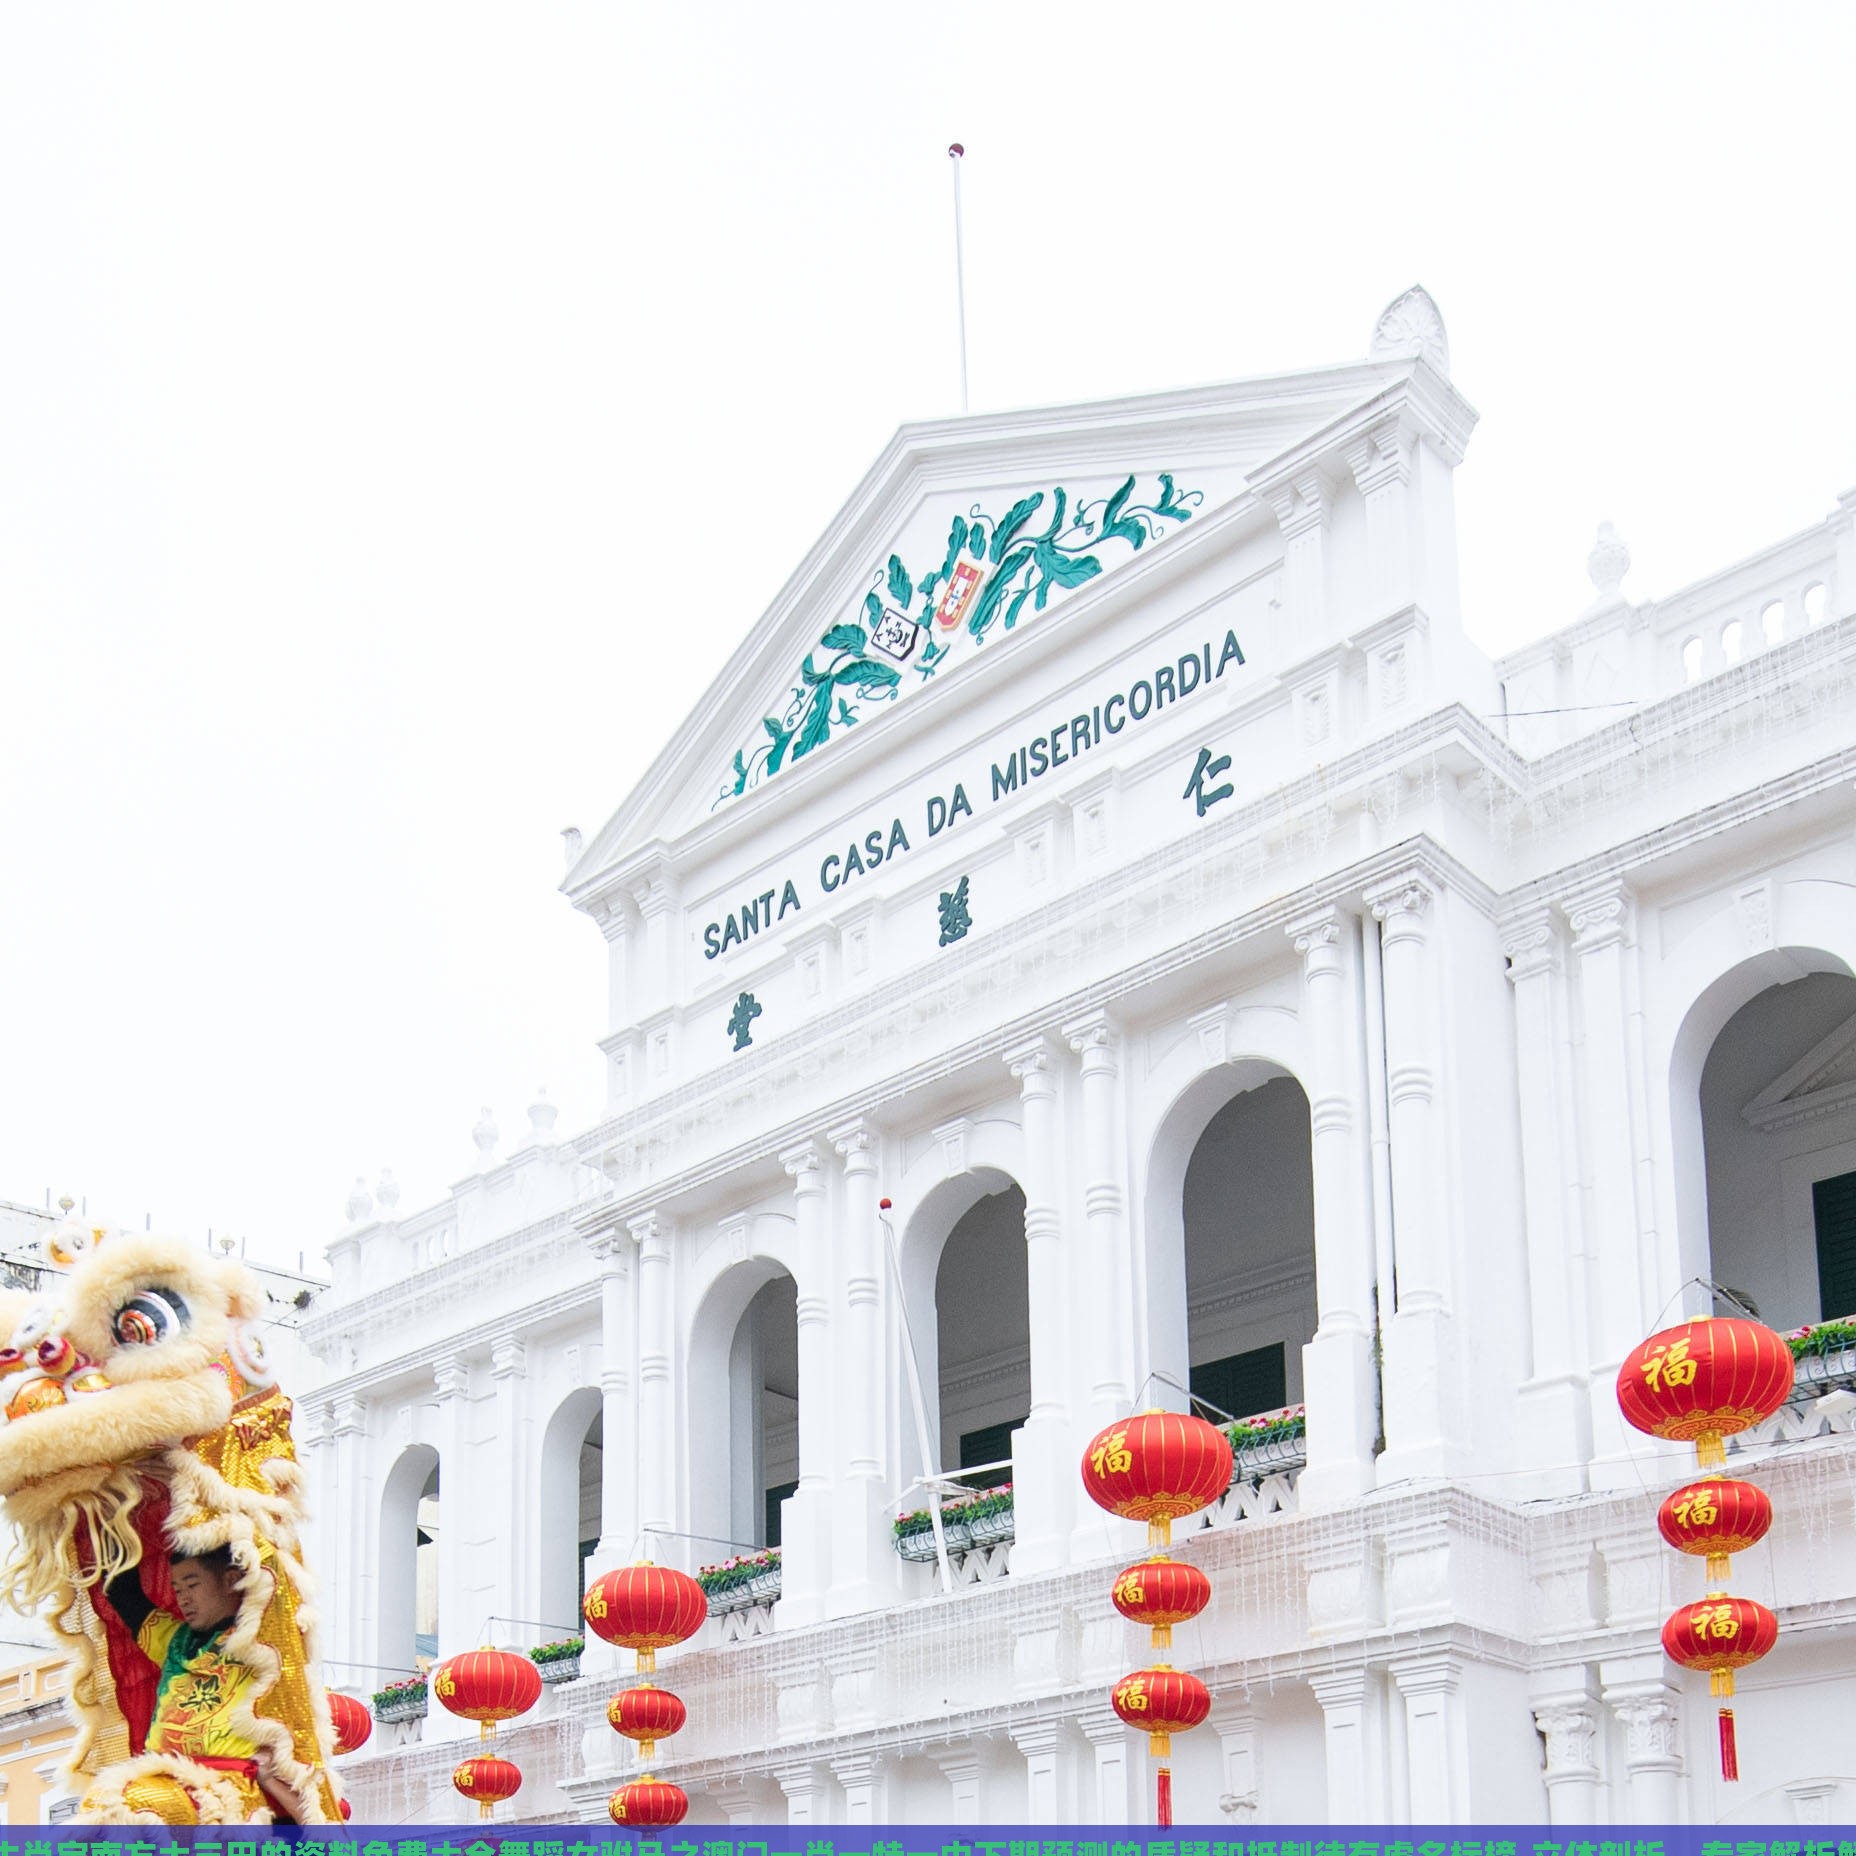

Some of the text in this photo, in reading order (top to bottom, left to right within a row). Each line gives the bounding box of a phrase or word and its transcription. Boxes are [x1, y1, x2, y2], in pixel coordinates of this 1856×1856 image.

[703, 879, 801, 961] SANTA
[820, 818, 911, 894] CASA
[927, 785, 973, 837] DA
[991, 629, 1247, 804] MISERICORDIA
[1642, 1337, 1699, 1393] 福
[1091, 1430, 1133, 1479] 福
[1674, 1490, 1717, 1527] 福
[1116, 1573, 1145, 1607] 福
[1692, 1603, 1739, 1641] 福
[1116, 1677, 1148, 1715] 福
